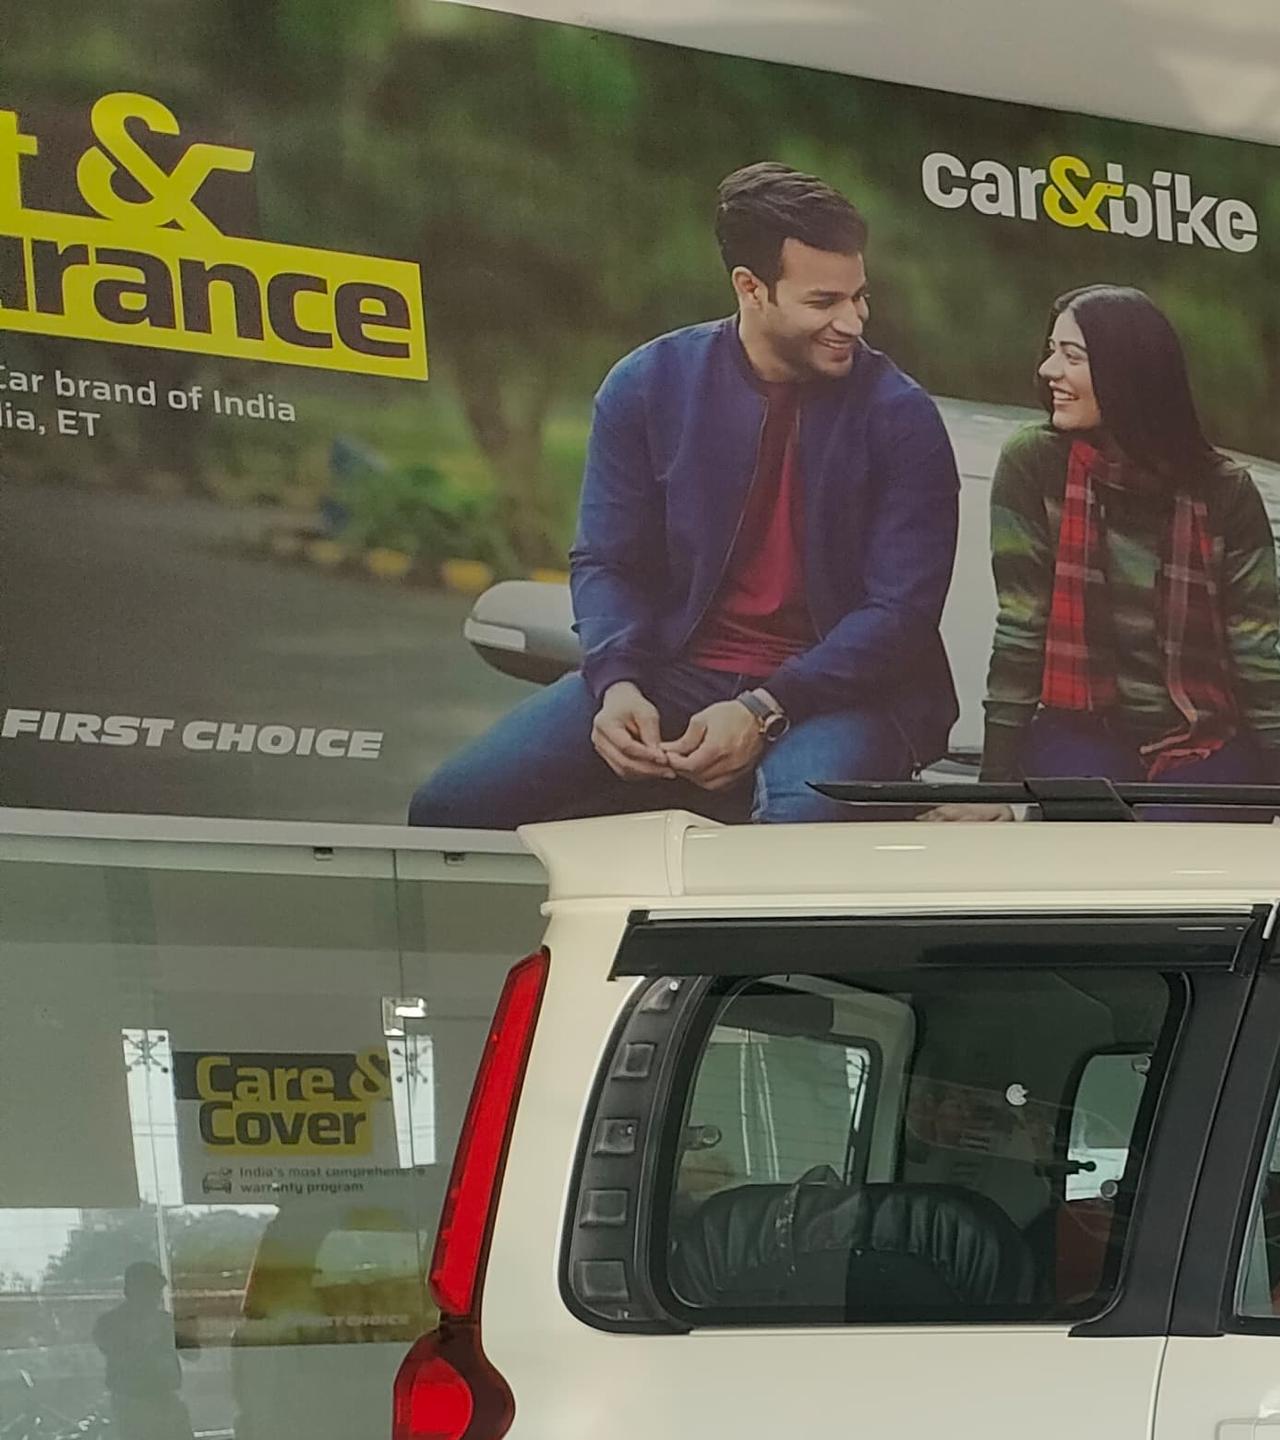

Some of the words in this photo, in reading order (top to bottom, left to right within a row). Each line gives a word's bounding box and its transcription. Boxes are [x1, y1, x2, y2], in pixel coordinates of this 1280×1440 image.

[922, 151, 1259, 253] car&bike
[55, 369, 156, 406] brand
[168, 386, 202, 411] of
[213, 389, 296, 421] India
[0, 402, 46, 435] ia,
[57, 409, 100, 437] ET
[0, 708, 175, 748] FIRST
[182, 721, 384, 760] CHOICE
[196, 1055, 335, 1101] Care
[199, 1101, 367, 1146] Cover
[239, 1166, 285, 1178] India's
[288, 1166, 322, 1178] most
[306, 1182, 365, 1195] program
